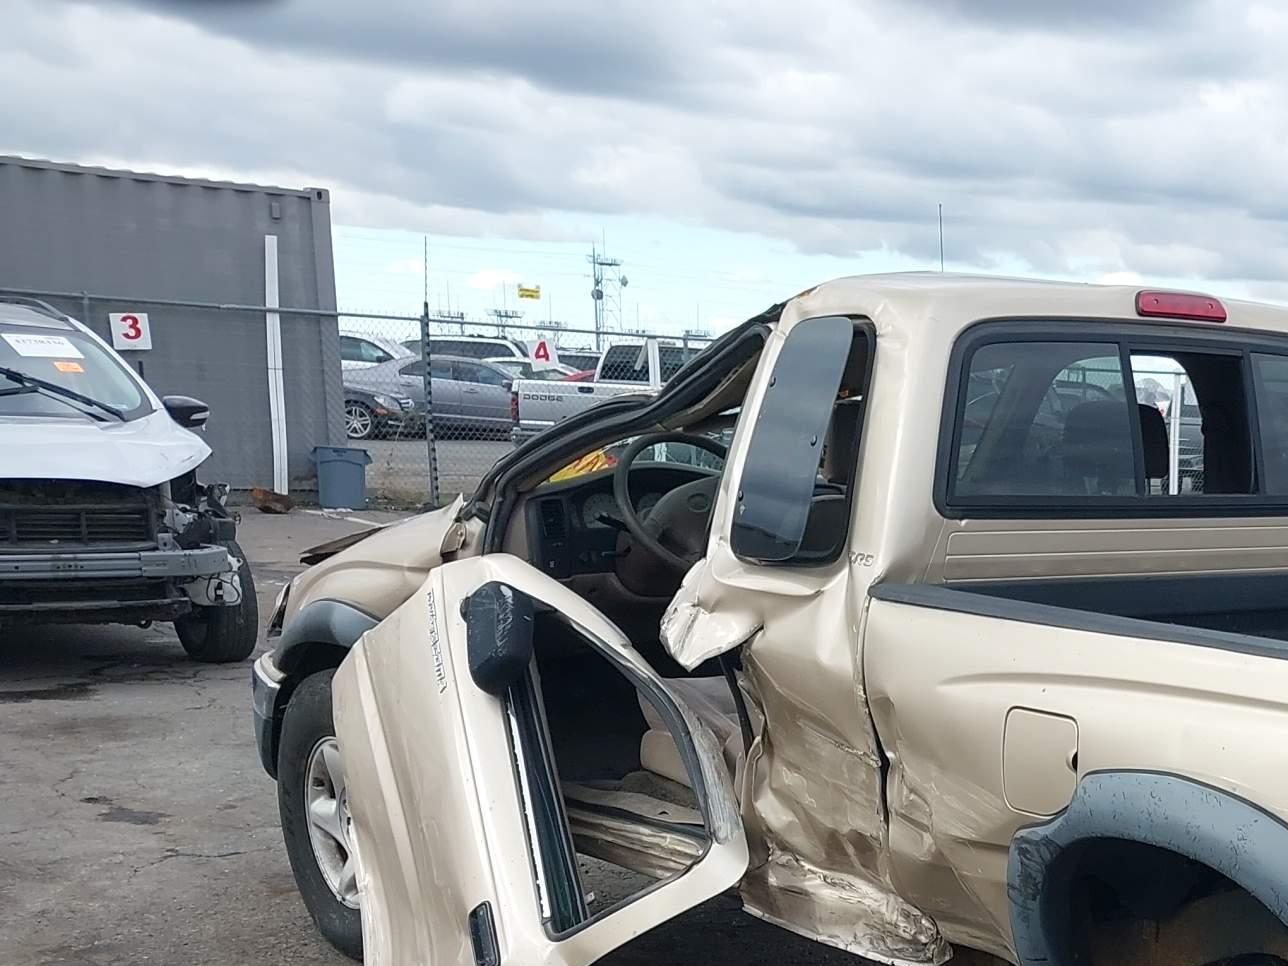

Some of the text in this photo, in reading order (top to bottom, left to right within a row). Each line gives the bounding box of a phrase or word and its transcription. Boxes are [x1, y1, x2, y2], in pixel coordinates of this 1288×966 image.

[120, 315, 141, 340] 3
[535, 341, 549, 361] 4
[523, 393, 564, 402] DODGE
